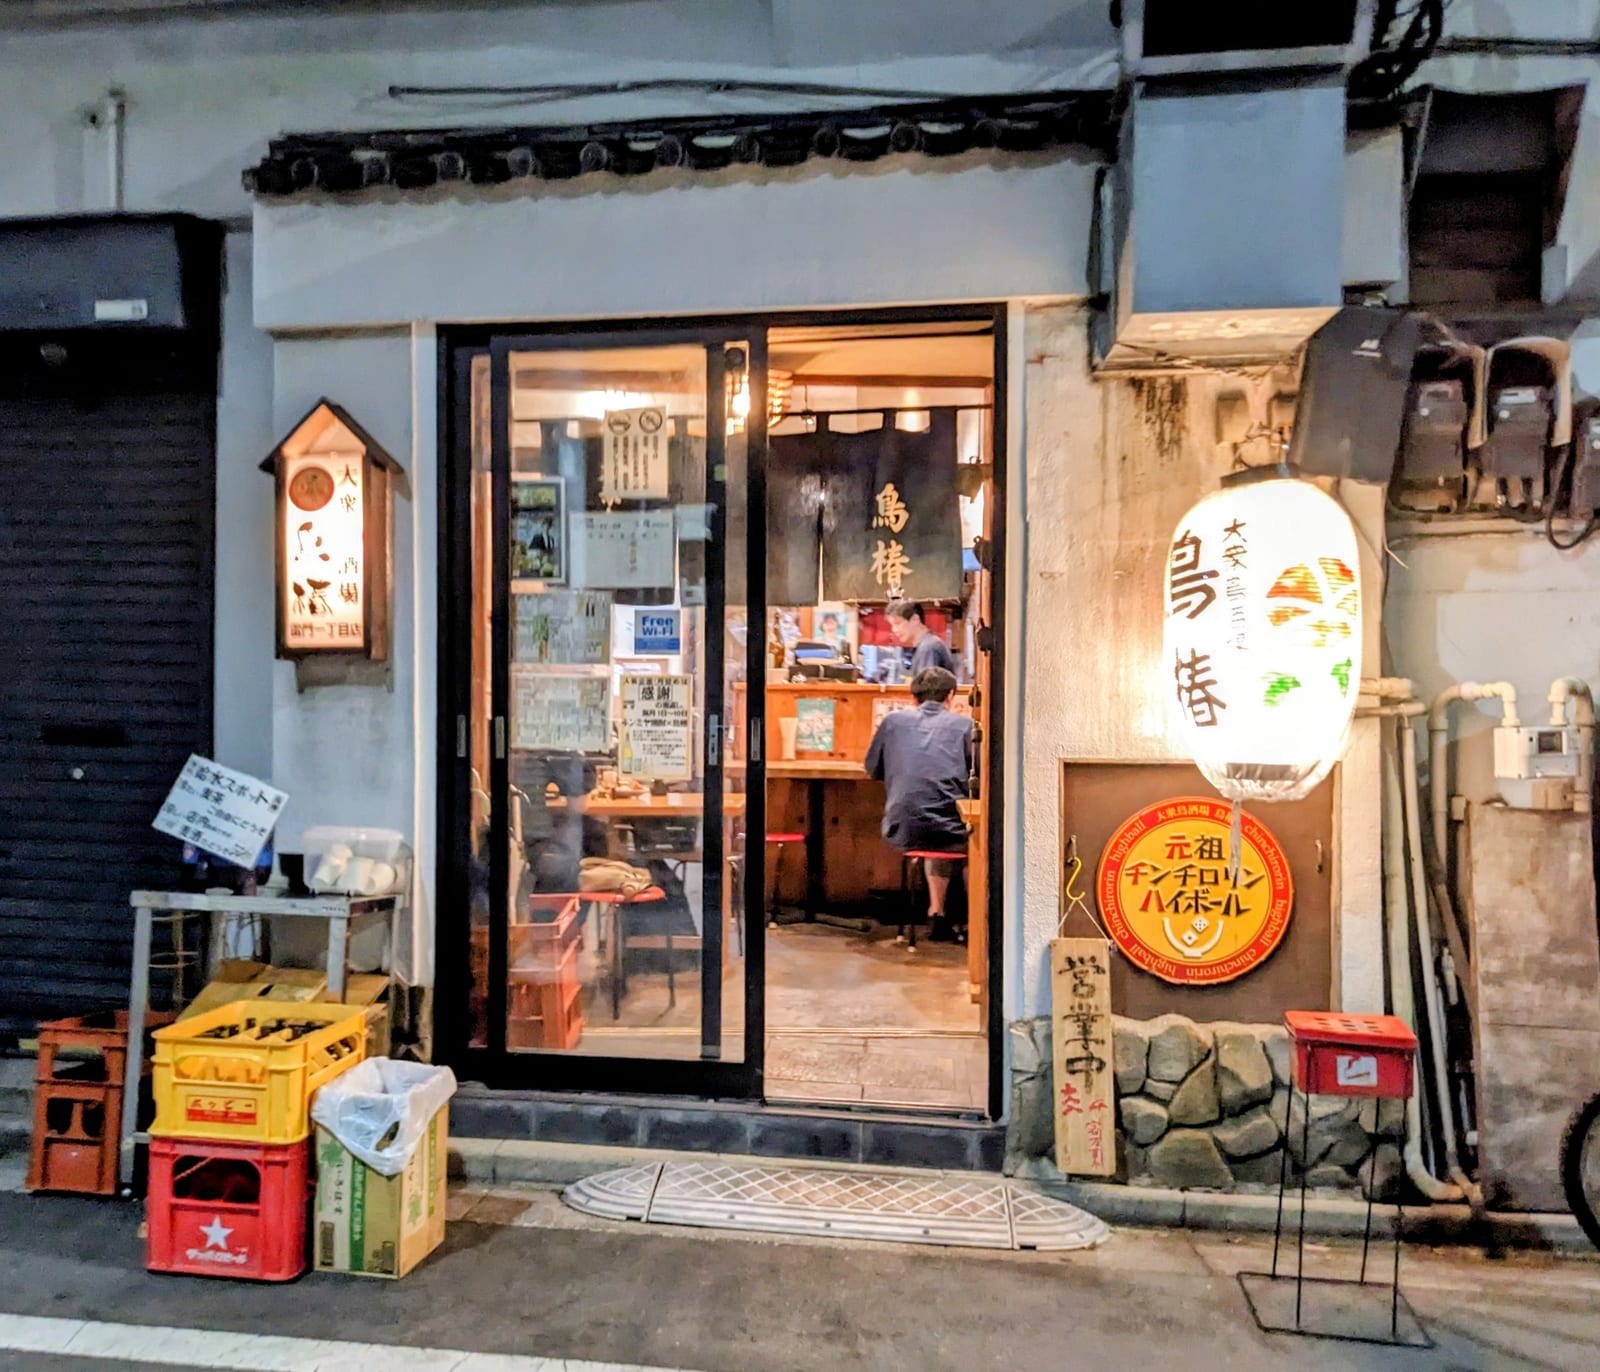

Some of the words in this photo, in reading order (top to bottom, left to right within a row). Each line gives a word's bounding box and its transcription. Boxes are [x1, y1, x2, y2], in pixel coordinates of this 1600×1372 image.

[869, 482, 913, 586] 鳥椿
[641, 616, 674, 626] Free
[642, 627, 673, 637] Wi-Fi
[1168, 529, 1227, 727] 鳥椿
[641, 686, 671, 700] 感謝
[1112, 820, 1147, 864] highball
[1165, 834, 1226, 861] 元祖
[1243, 823, 1286, 891] chinchirorin
[1124, 862, 1265, 890] チンチロリン
[1104, 869, 1130, 941] chinchirorin
[1138, 888, 1252, 918] ハイボール
[1259, 898, 1288, 948] highball
[1129, 942, 1178, 977] highball
[1185, 948, 1257, 980] chinchirorin
[1057, 956, 1107, 1095] 営業中
